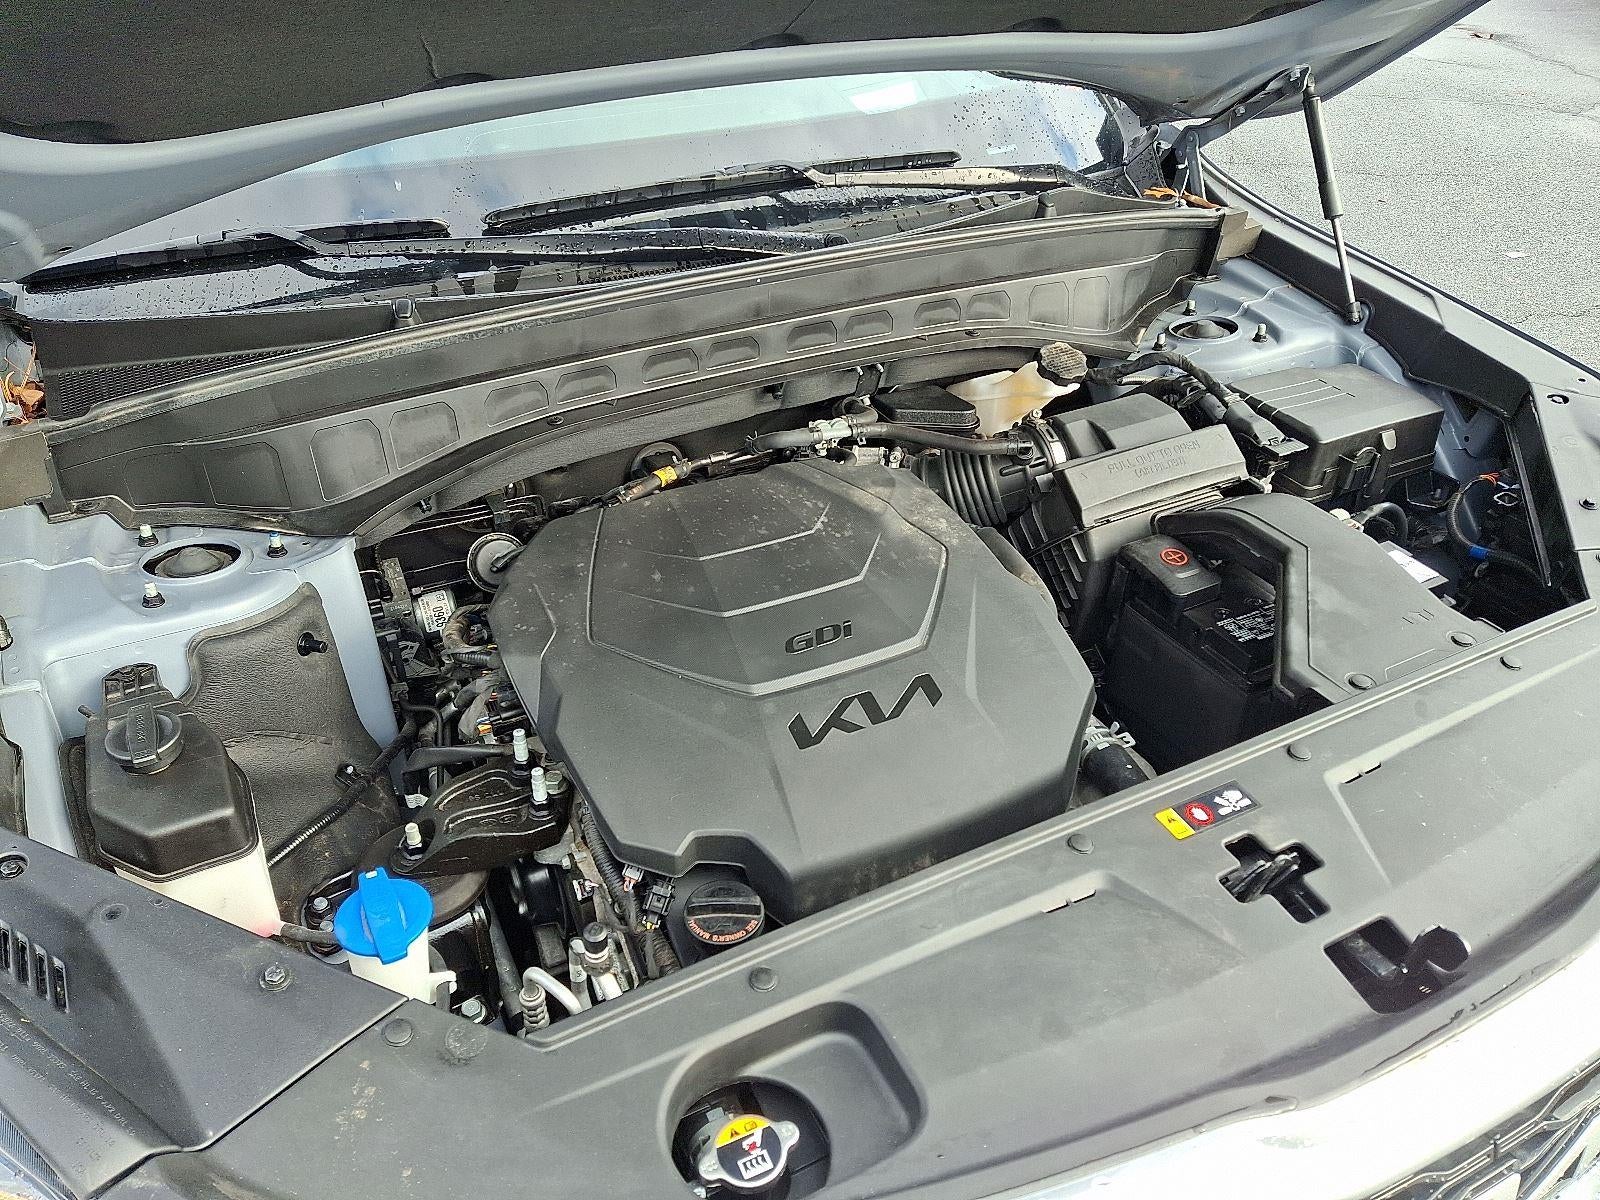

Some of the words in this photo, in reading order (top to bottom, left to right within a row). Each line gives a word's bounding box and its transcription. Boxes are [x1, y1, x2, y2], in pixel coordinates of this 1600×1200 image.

[1107, 459, 1135, 474] PULL
[1136, 451, 1155, 465] OUT
[1156, 447, 1172, 457] TO
[1174, 439, 1200, 454] OPEN
[433, 606, 448, 627] 9360
[785, 619, 852, 654] GDi
[687, 919, 711, 939] MANUAL
[745, 919, 758, 932] SEE
[712, 930, 747, 942] OWNER'S
